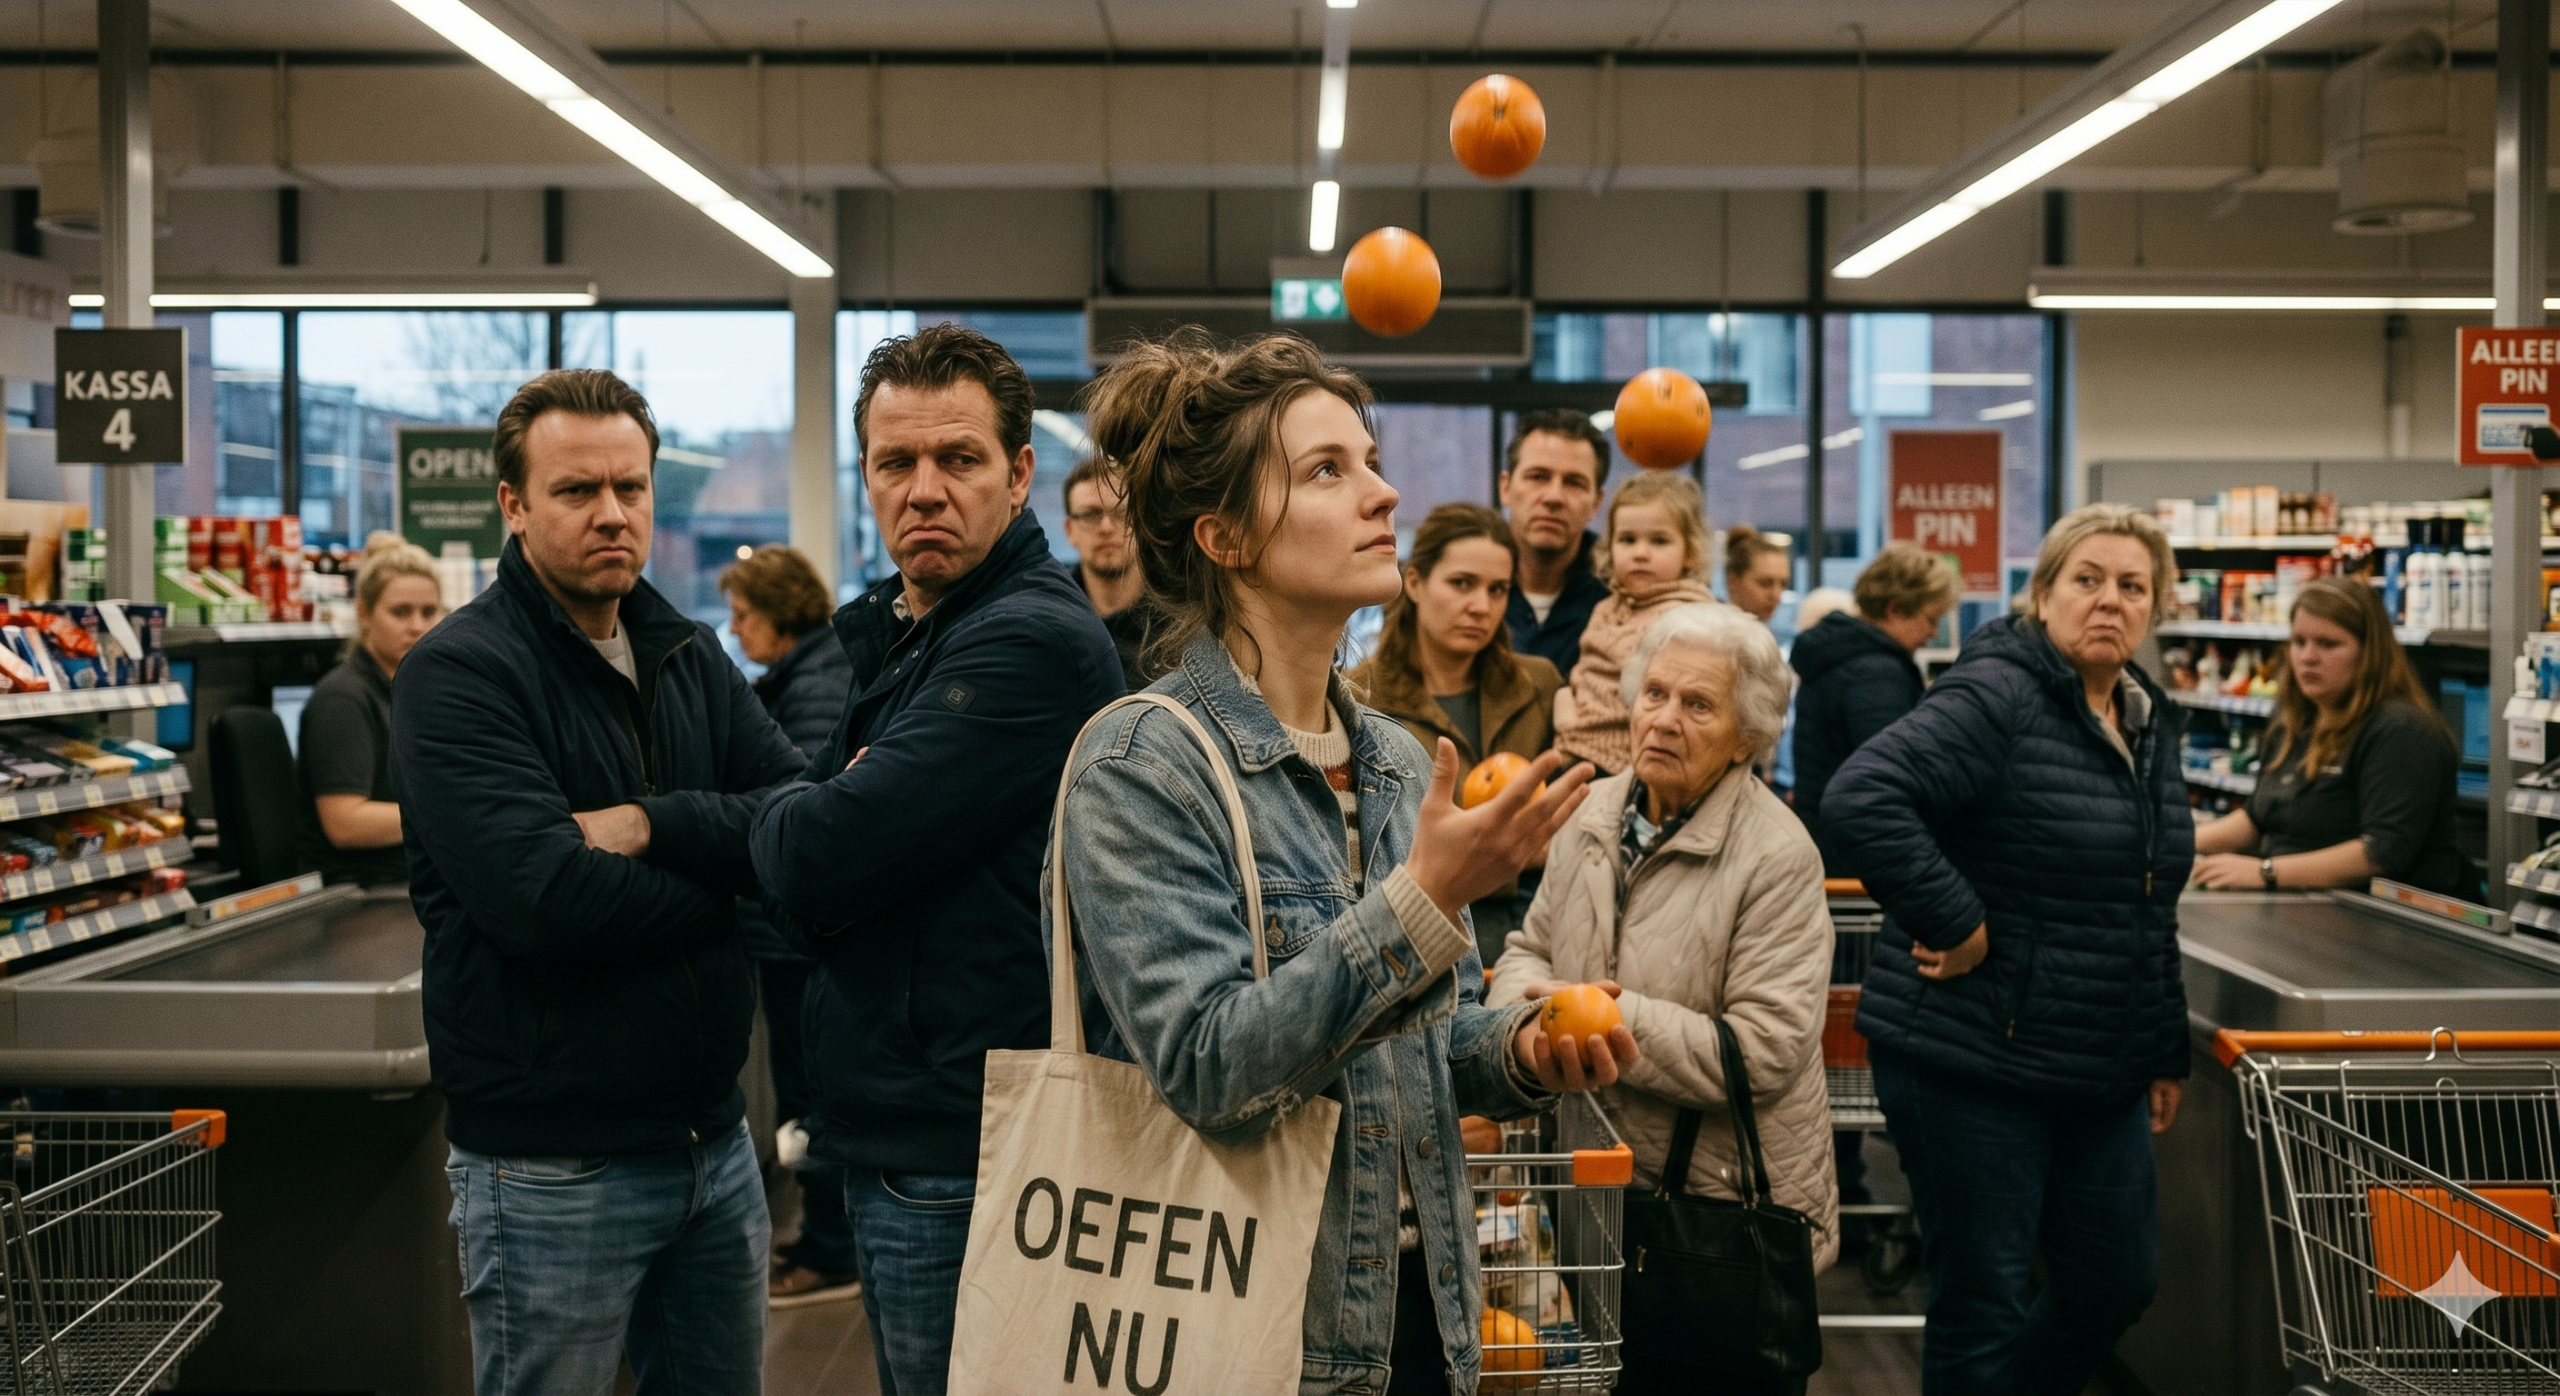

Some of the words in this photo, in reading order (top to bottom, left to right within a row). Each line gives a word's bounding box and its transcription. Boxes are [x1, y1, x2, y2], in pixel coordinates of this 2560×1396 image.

[64, 369, 174, 400] KASSA
[2500, 367, 2548, 394] PIN
[102, 407, 137, 452] 4
[1898, 482, 1990, 510] ALLEEN
[1914, 512, 1976, 546] PIN
[1014, 1176, 1258, 1299] OEFEN
[1063, 1301, 1180, 1396] NU
